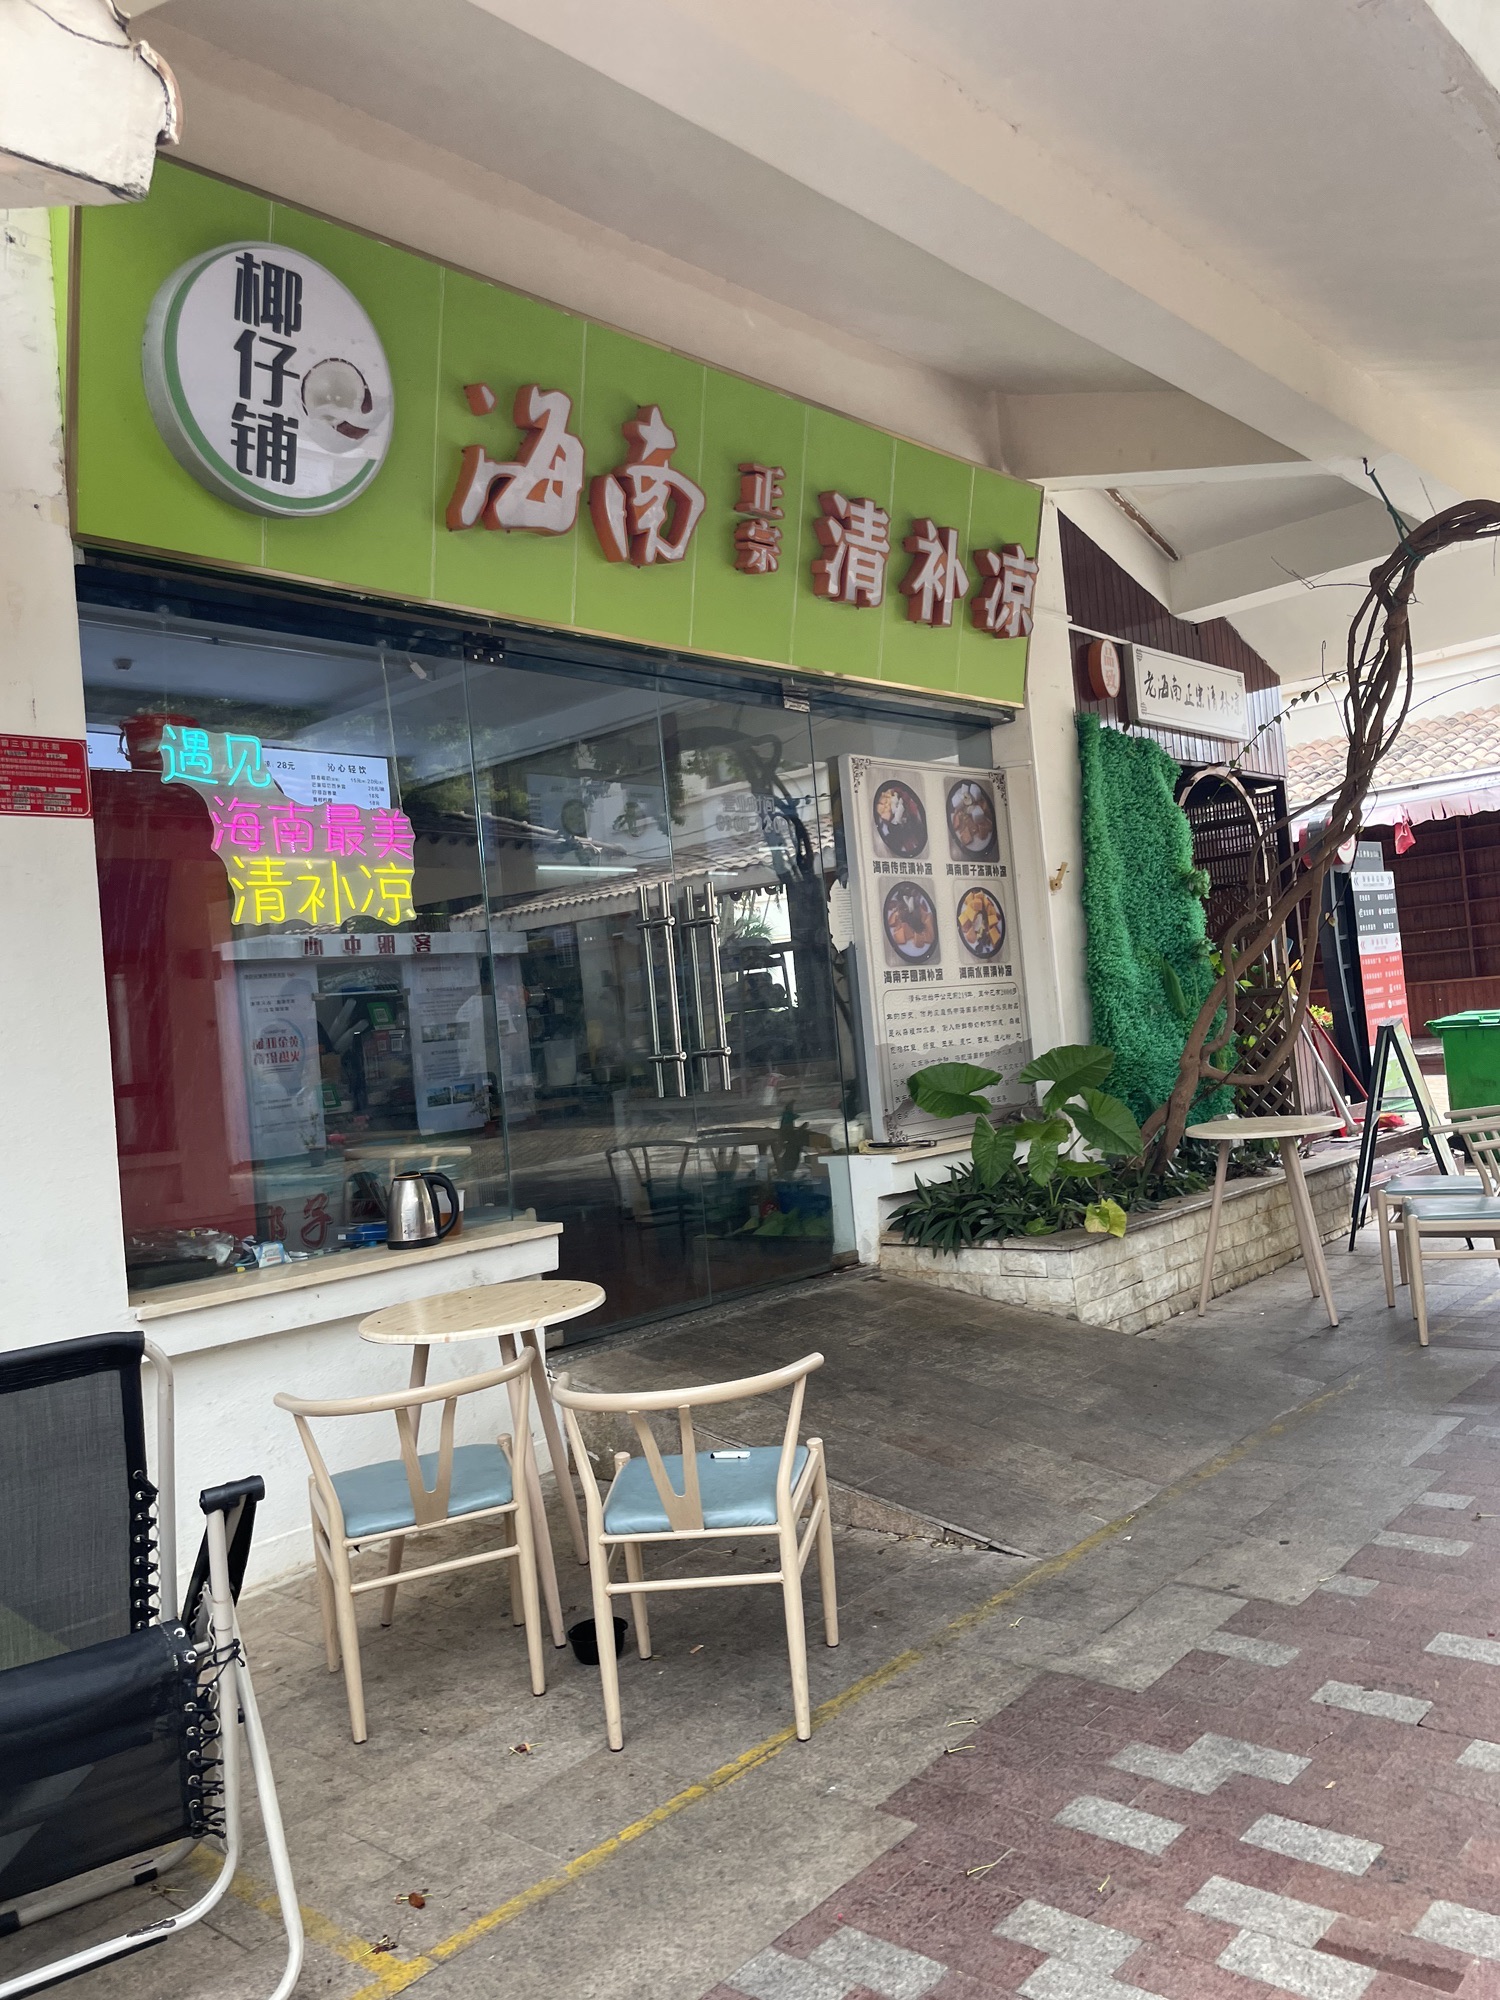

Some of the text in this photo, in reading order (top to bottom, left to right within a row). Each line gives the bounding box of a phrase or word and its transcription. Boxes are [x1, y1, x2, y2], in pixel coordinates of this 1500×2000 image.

[231, 252, 303, 486] 椰仔铺
[445, 383, 1039, 640] 海南 正宗 清补凉
[159, 725, 271, 788] 遇见
[327, 763, 367, 775] 沁心轻饮
[210, 795, 414, 860] 海南最美
[231, 855, 415, 924] 清补凉
[872, 860, 933, 876] 海南传统清补凉
[884, 968, 944, 984] 海南芋圆清补凉
[958, 964, 1013, 980] 海南水果清补凉
